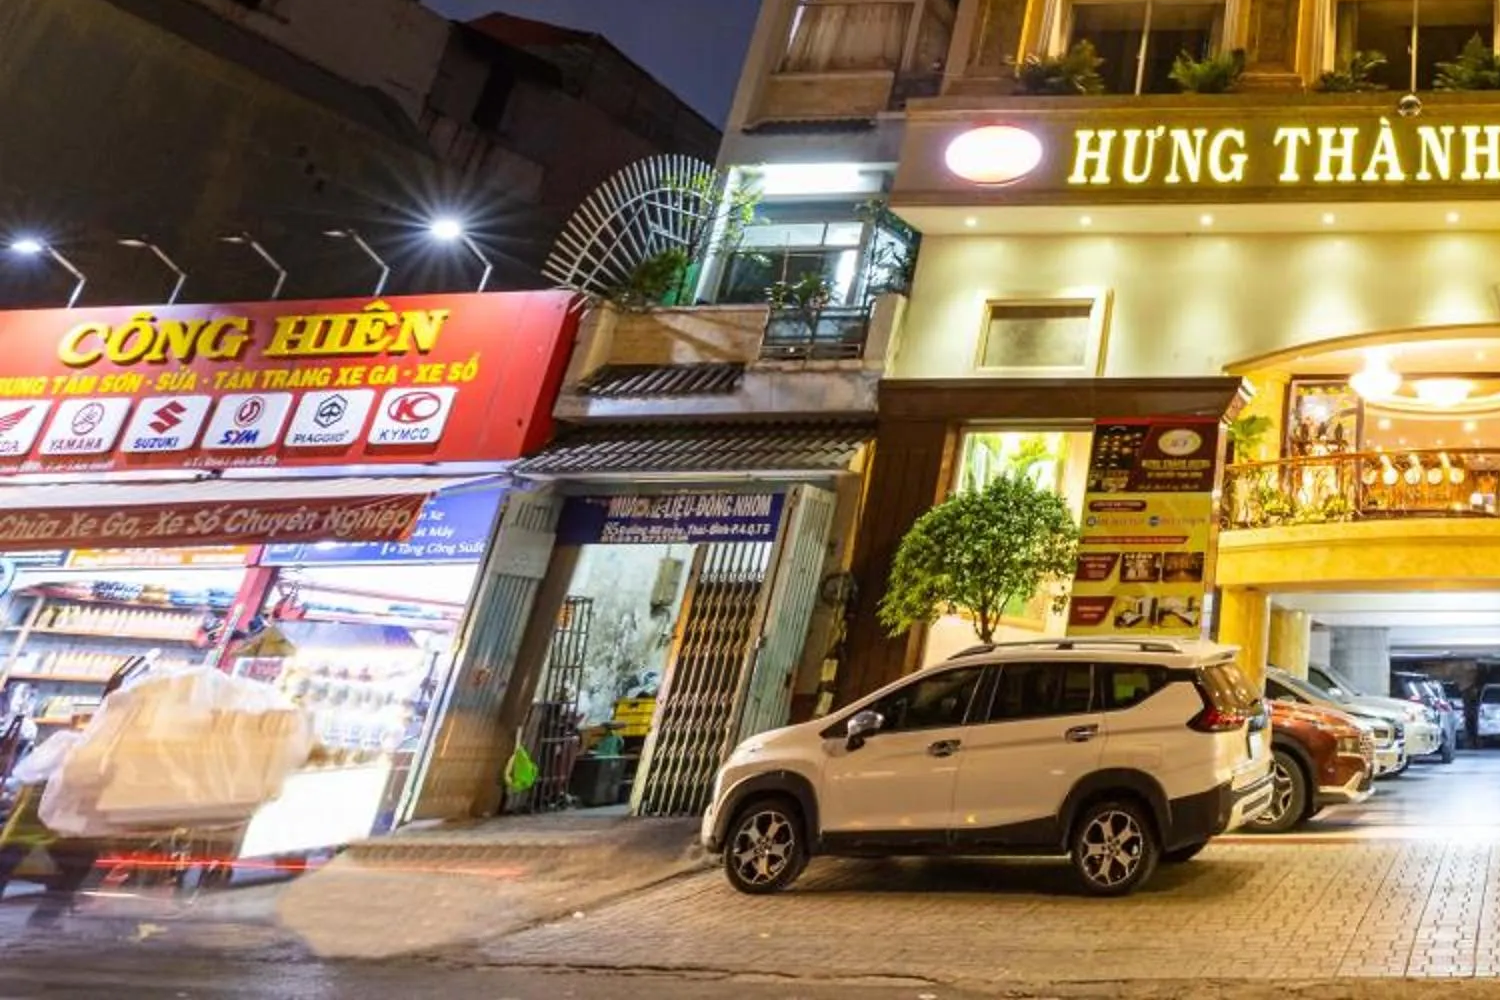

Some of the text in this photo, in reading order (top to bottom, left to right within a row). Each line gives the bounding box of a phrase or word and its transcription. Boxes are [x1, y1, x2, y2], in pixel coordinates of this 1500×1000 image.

[1067, 124, 1249, 184] HƯNG
[58, 310, 250, 368] CÔNG
[261, 367, 331, 388] TRANG
[335, 366, 365, 386] XE
[368, 364, 398, 384] GA
[413, 363, 445, 384] XE
[49, 437, 104, 450] YAMAHA
[133, 437, 180, 449] SUZUKI
[219, 429, 260, 445] SYM
[378, 428, 430, 441] KYMCO
[61, 511, 97, 538] Xe
[149, 510, 185, 537] Xe
